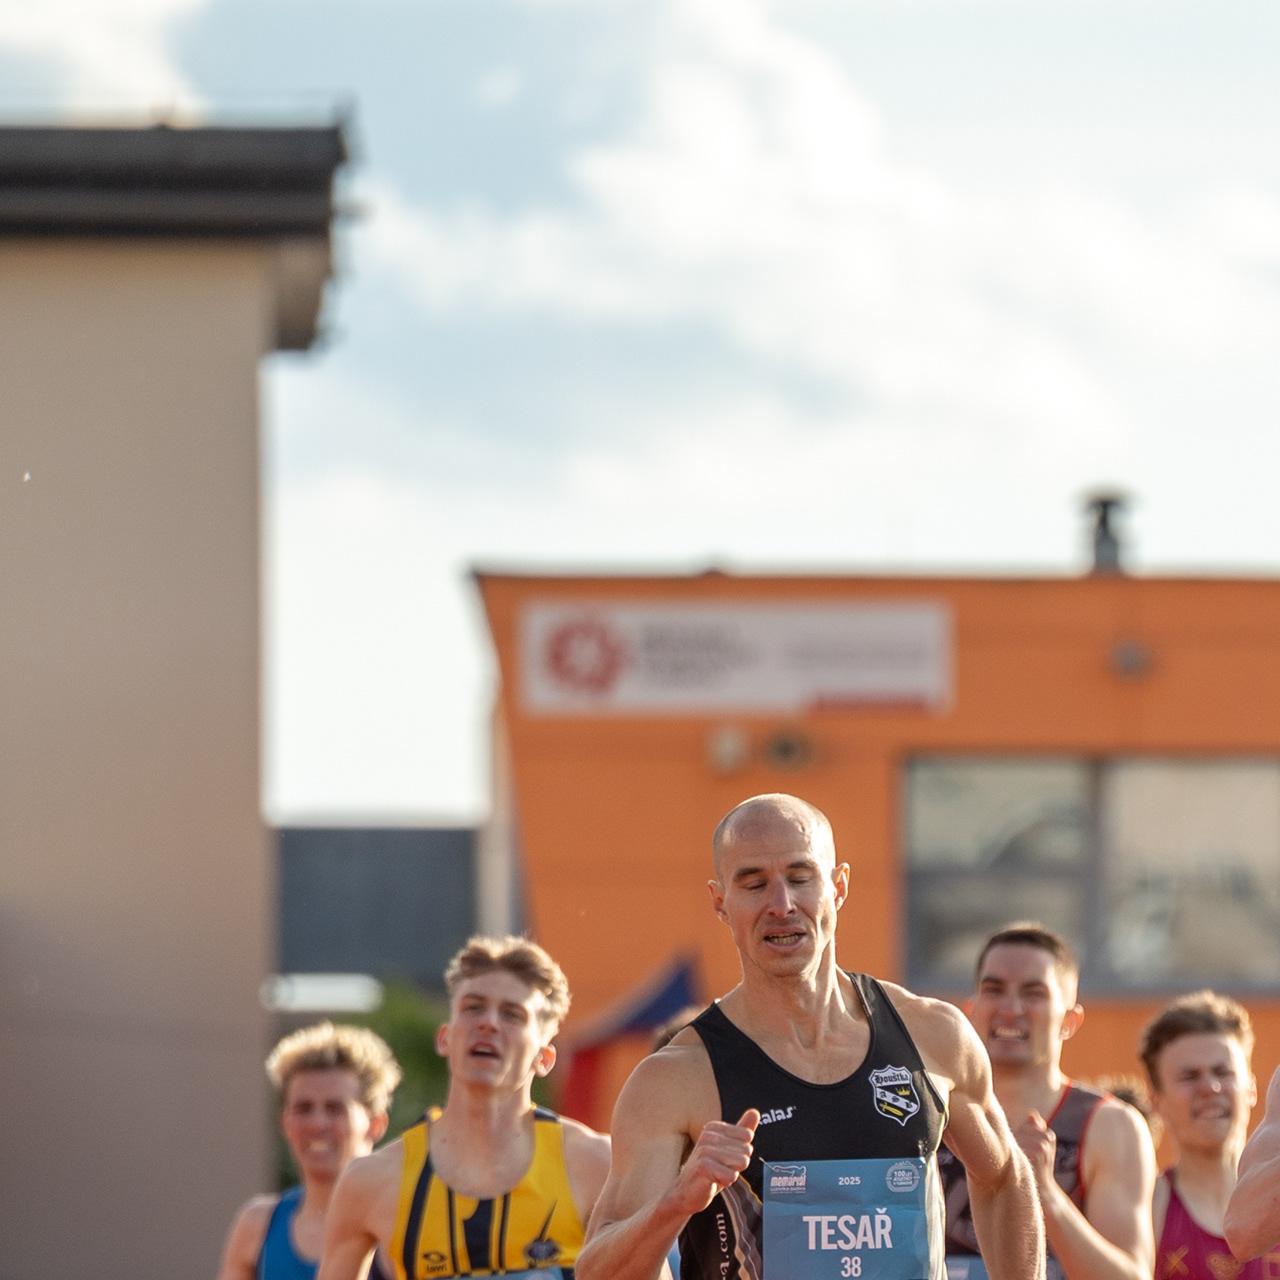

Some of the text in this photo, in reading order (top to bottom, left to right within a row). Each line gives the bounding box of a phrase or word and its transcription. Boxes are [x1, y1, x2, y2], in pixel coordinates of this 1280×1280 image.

[758, 1106, 794, 1126] alas
[838, 1176, 861, 1186] 2025
[802, 1207, 893, 1250] TESAŘ
[840, 1256, 862, 1277] 38
